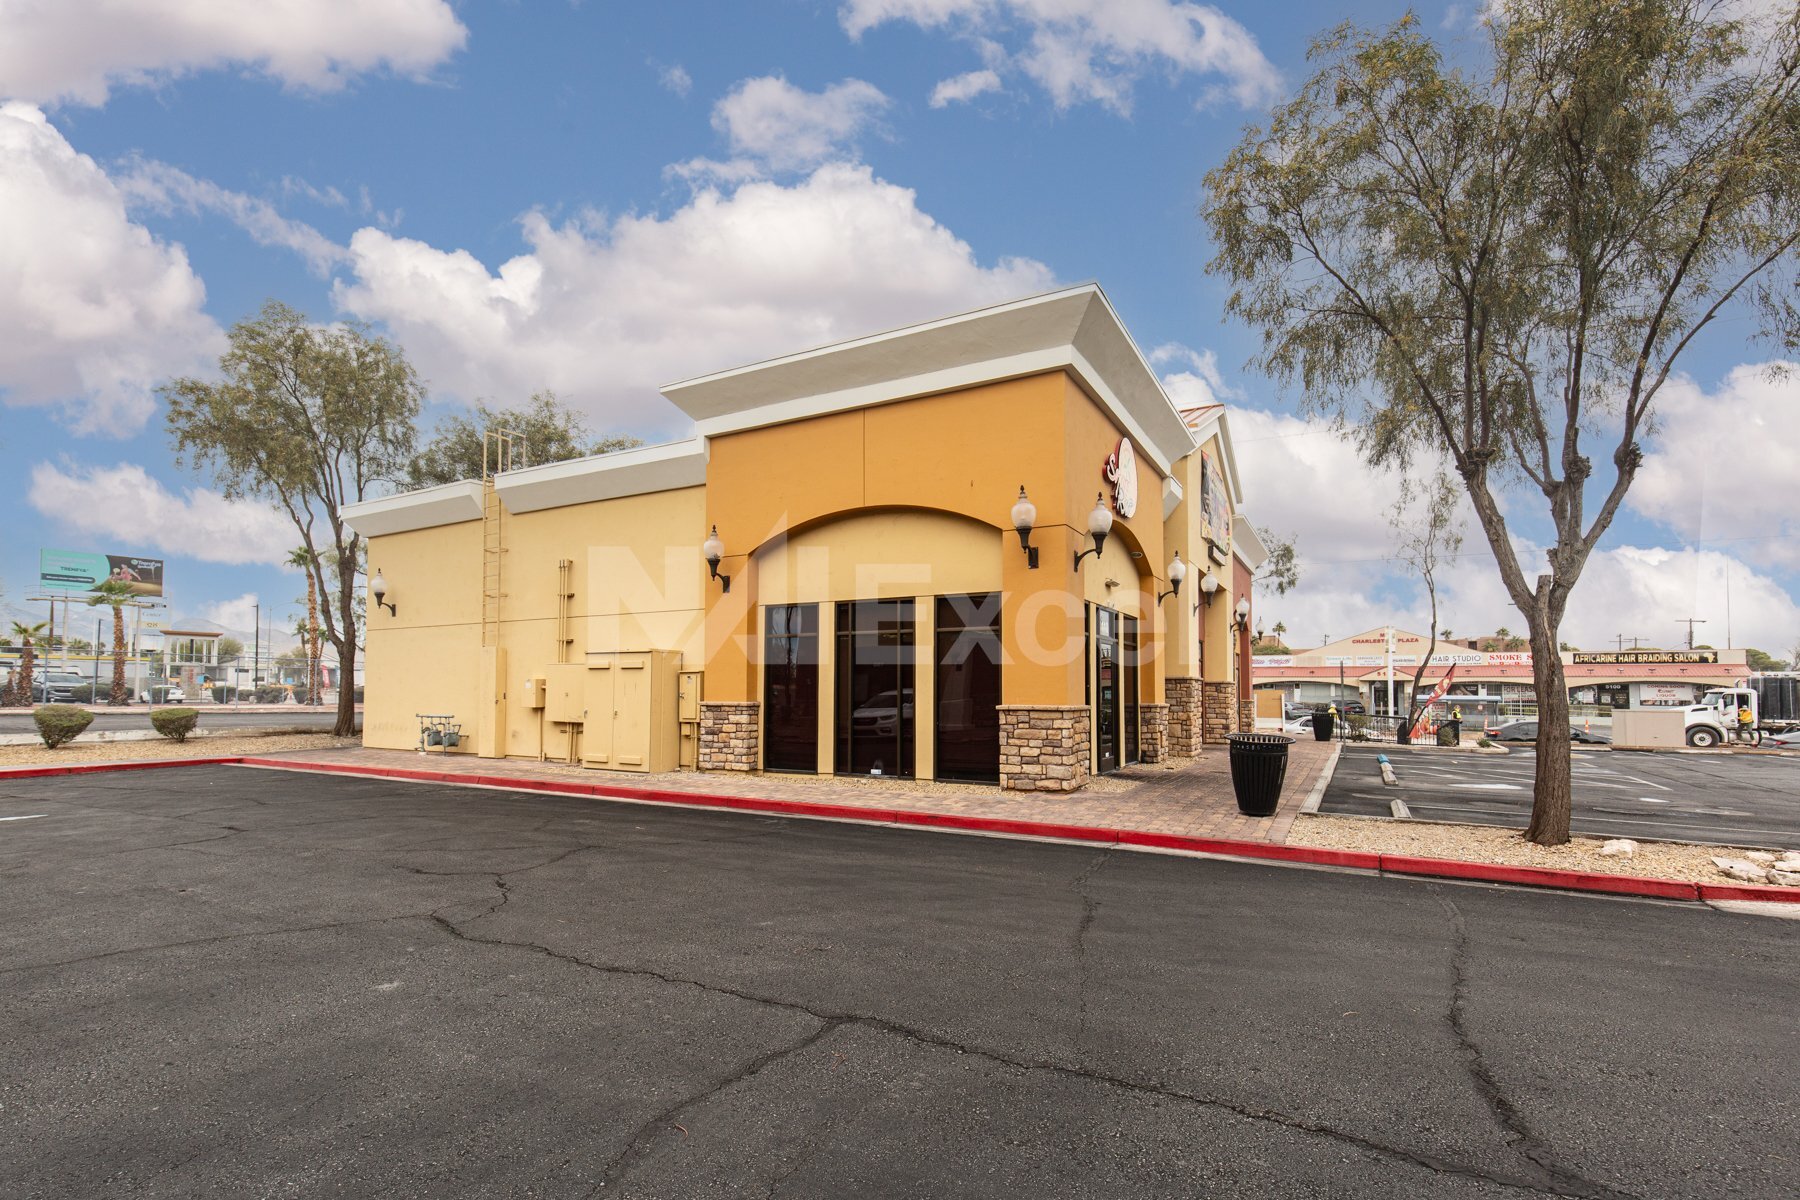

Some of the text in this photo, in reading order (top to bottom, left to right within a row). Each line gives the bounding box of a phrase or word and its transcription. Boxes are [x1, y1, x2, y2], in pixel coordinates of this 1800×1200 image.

[1574, 652, 1699, 663] AFRICARINE HAIR BRAIDING SALON
